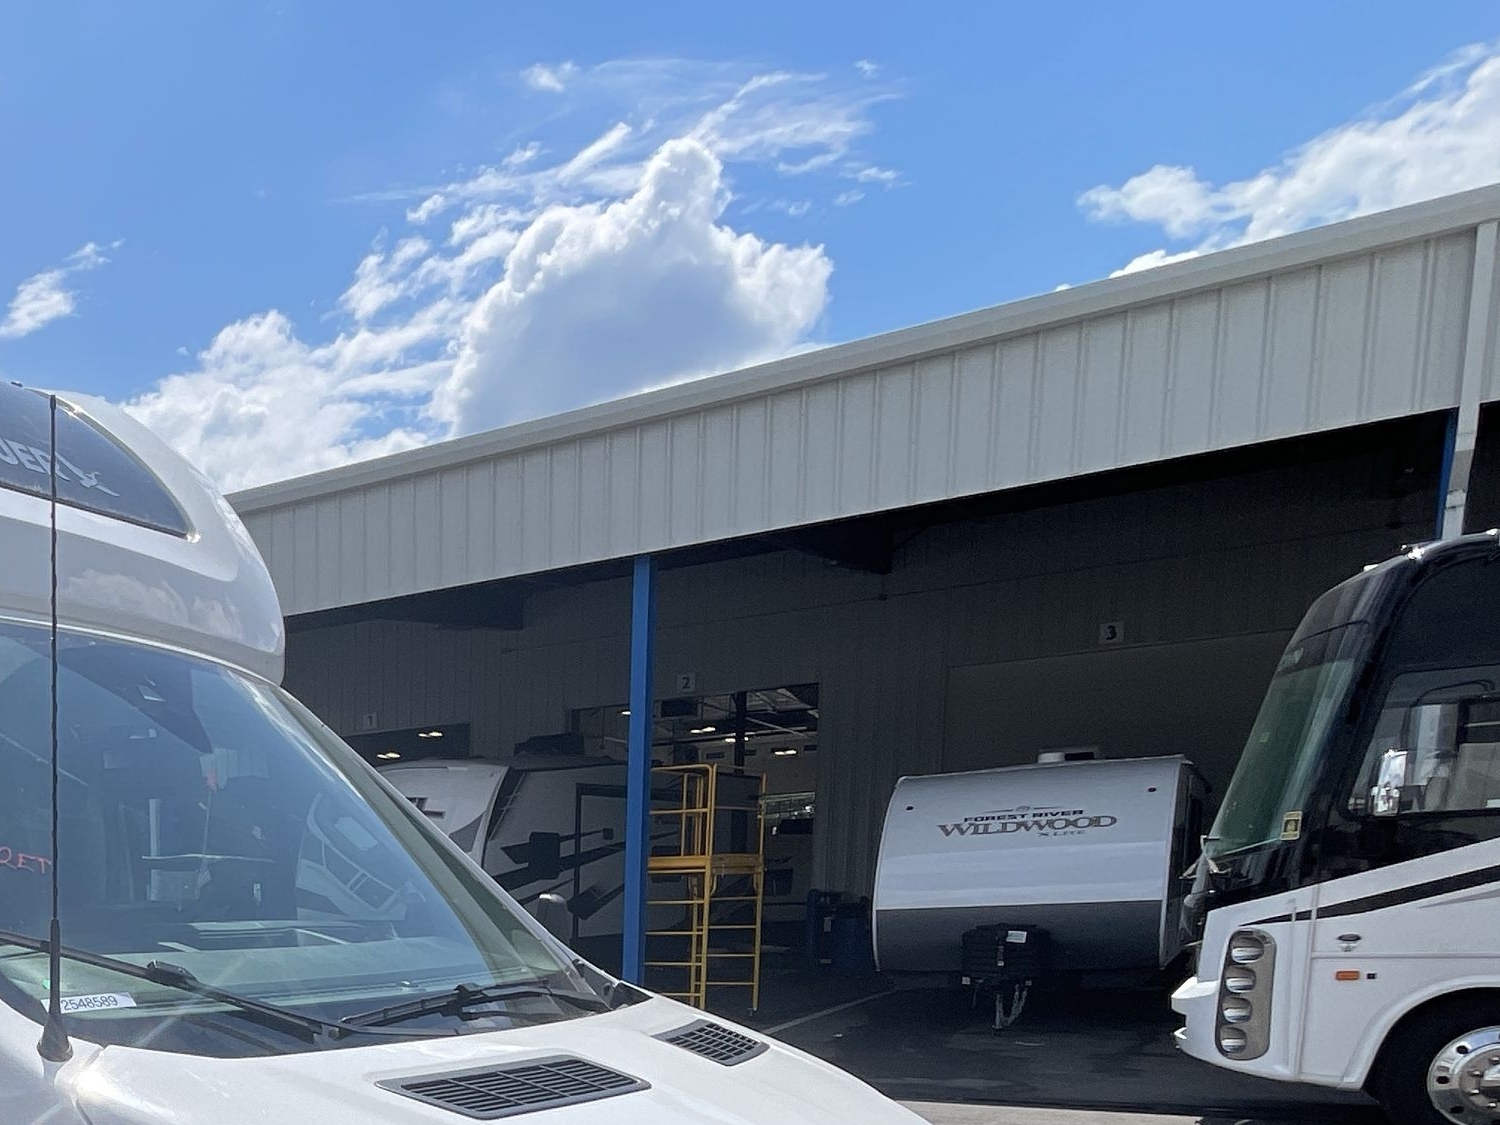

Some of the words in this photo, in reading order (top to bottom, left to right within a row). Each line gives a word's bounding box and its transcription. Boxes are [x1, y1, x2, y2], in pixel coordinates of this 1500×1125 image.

[1106, 625, 1117, 640] 3
[682, 676, 691, 690] 2
[963, 814, 1025, 823] FOREST
[1032, 809, 1084, 818] RIVER
[937, 815, 1118, 837] WILDWOOD
[60, 995, 118, 1010] 2548589
